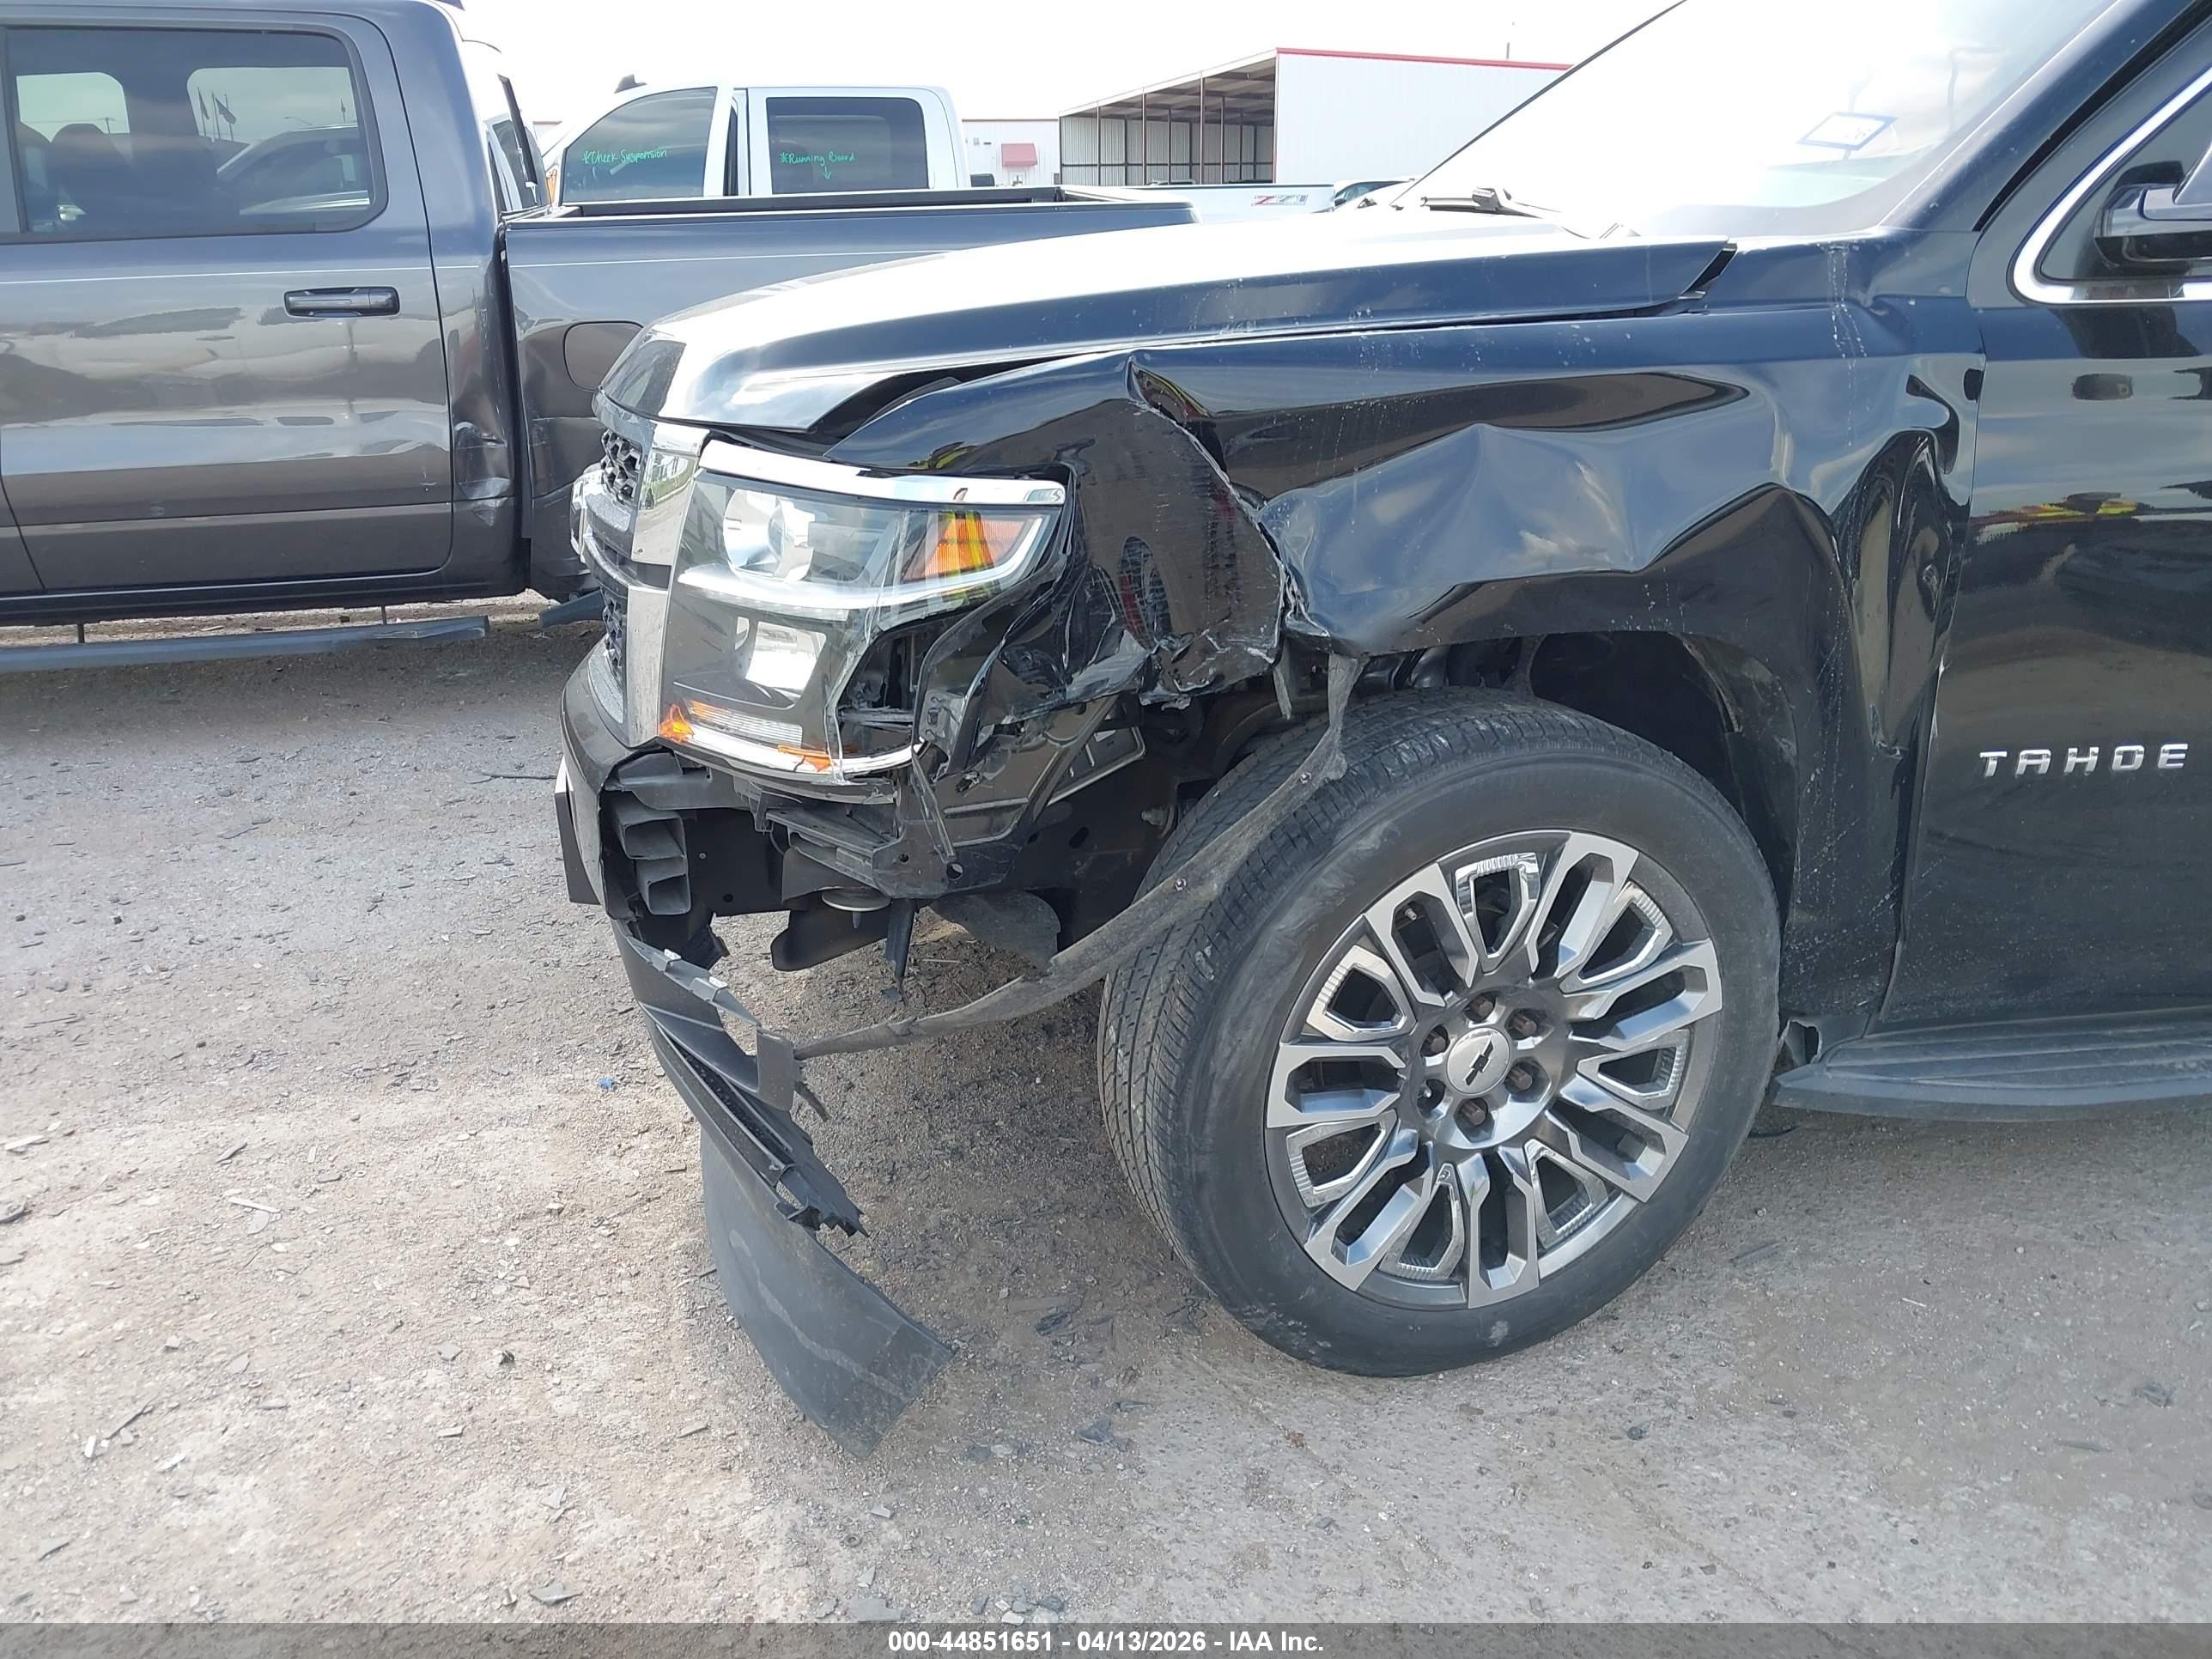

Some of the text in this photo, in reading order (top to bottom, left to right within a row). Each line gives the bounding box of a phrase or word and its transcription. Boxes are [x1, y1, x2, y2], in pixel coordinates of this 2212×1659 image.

[620, 149, 666, 163] Suspension
[788, 152, 825, 167] Running
[1978, 744, 2188, 777] TAHOE
